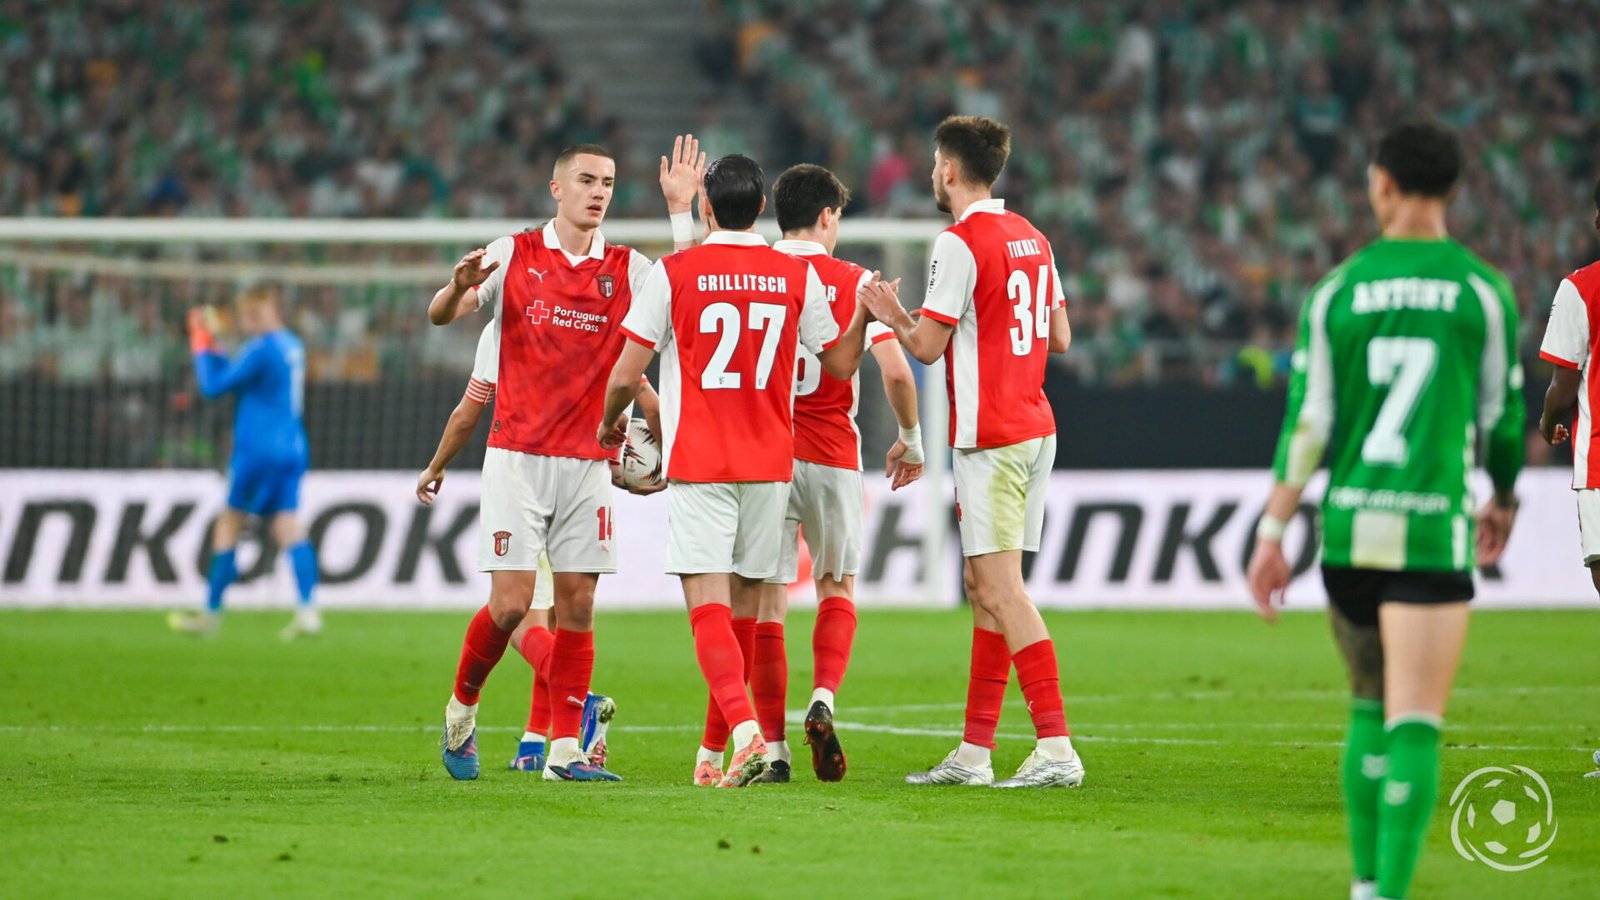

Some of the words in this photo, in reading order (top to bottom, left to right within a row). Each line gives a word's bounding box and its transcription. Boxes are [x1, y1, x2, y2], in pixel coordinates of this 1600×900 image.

[697, 273, 787, 294] GRILLITSCH
[1006, 264, 1050, 356] 34
[552, 315, 572, 328] Red
[573, 319, 599, 333] Cross
[553, 305, 608, 323] Portuguese
[699, 301, 787, 390] 27
[1361, 335, 1439, 468] 7
